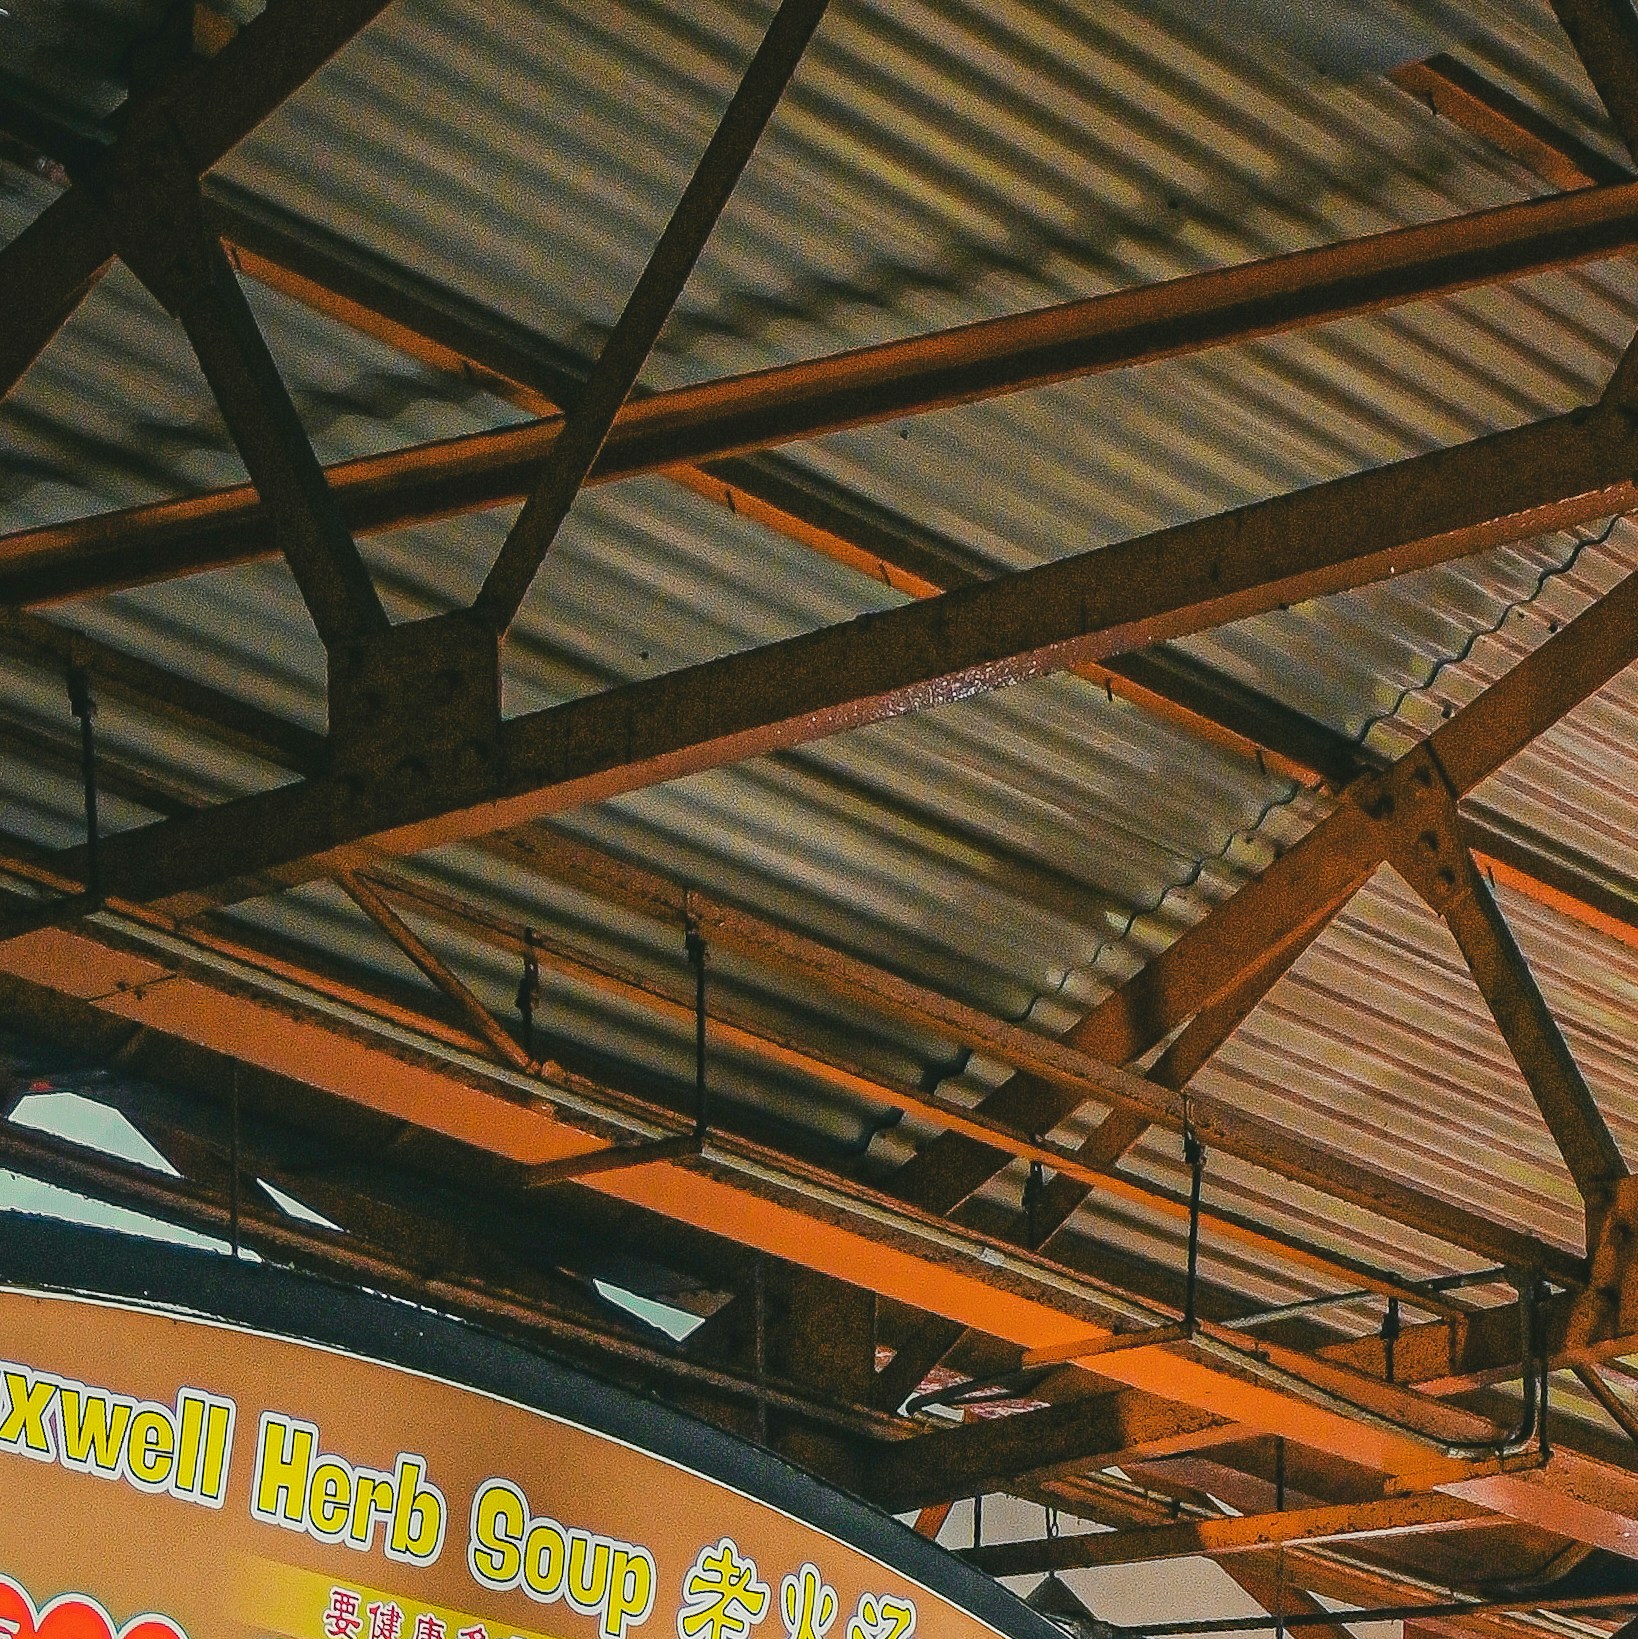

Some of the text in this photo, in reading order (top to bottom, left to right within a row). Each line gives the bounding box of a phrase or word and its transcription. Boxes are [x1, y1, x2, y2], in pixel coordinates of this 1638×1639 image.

[0, 1368, 652, 1639] xwell Herb Soup
